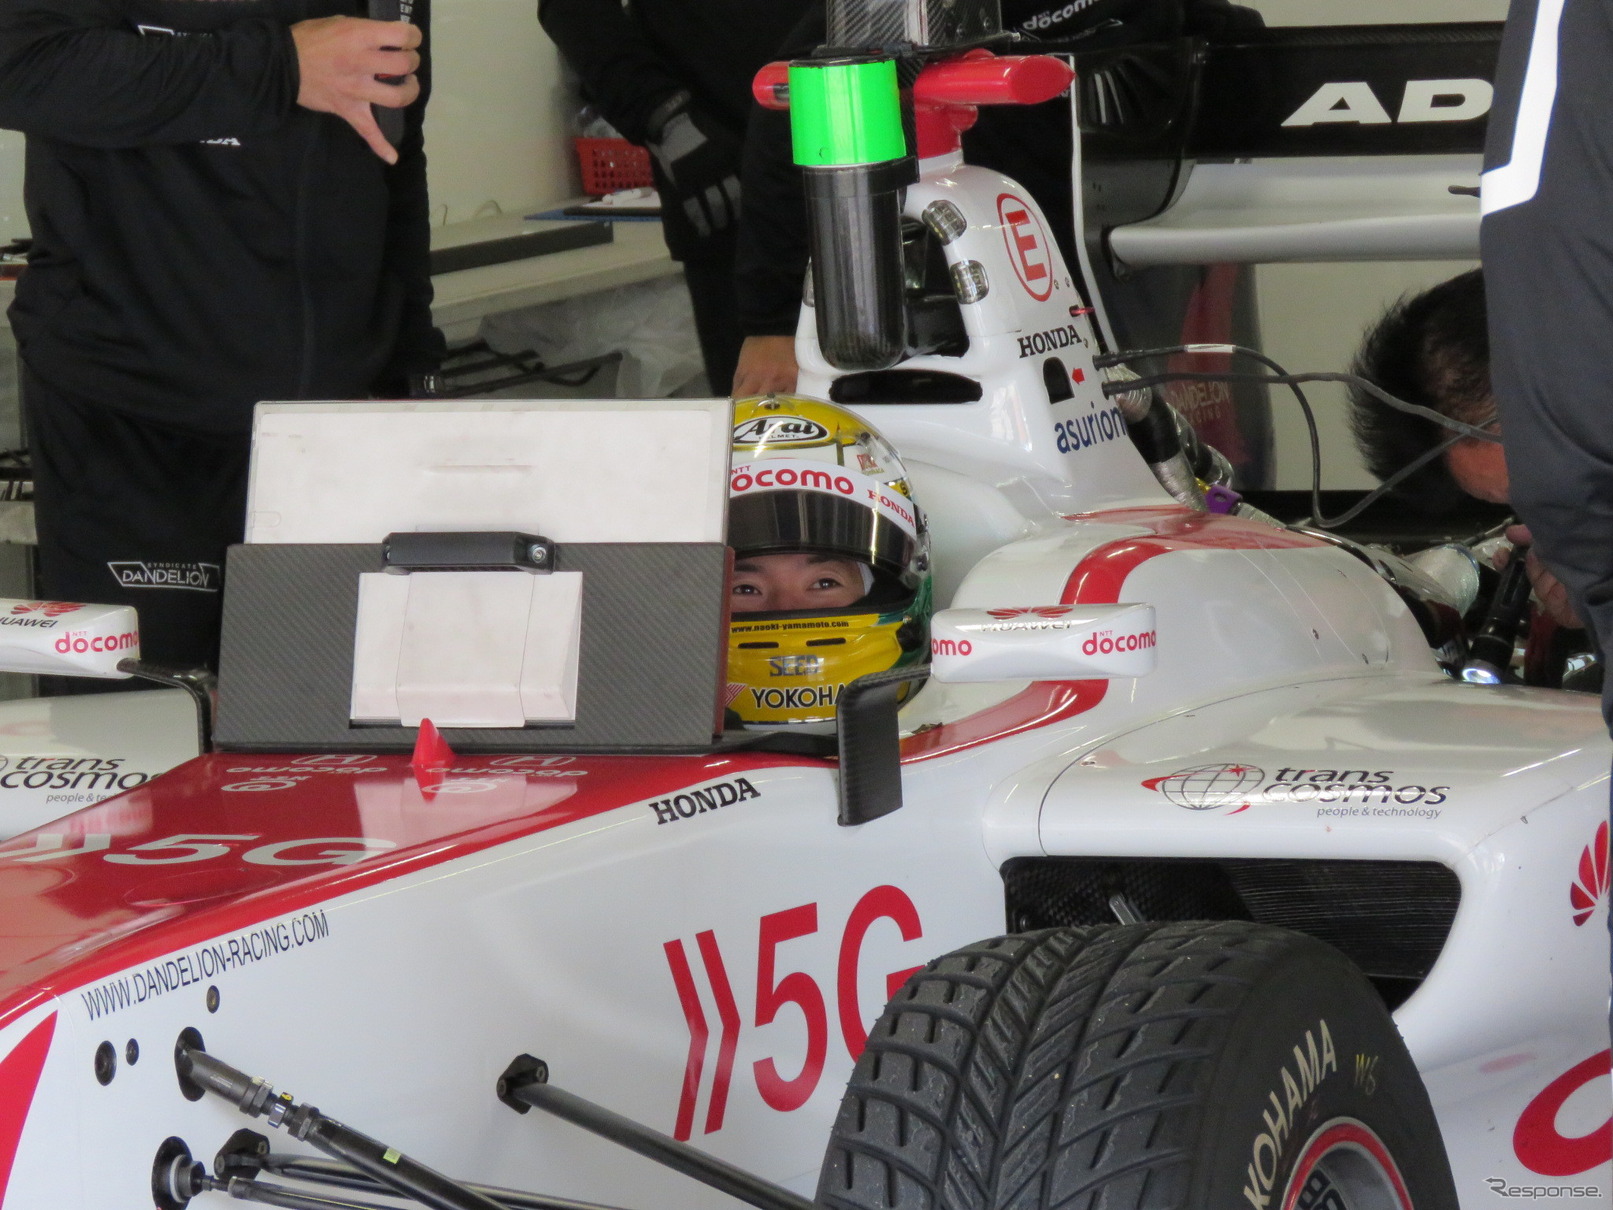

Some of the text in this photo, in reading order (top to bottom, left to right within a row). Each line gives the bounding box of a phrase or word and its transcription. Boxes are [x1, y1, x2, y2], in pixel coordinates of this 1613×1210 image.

[1023, 0, 1098, 30] docom
[1005, 210, 1047, 282] E
[1017, 324, 1082, 358] HONDA
[1054, 400, 1126, 454] asurion
[867, 489, 915, 528] HONDA
[122, 569, 209, 588] DANDELION
[147, 562, 197, 570] SYNDICATE
[731, 620, 849, 633] www.naoki-yamamoto.com
[55, 631, 139, 654] docomo
[1082, 629, 1156, 656] docomo
[16, 756, 125, 771] trans
[1275, 767, 1394, 783] trans
[46, 793, 84, 804] people
[85, 792, 94, 802] &
[648, 777, 761, 825] HONDA
[1263, 783, 1450, 805] cosmos
[1317, 807, 1442, 819] people & technology
[103, 833, 396, 865] 5G
[81, 909, 329, 1021] WWW.DANDELION-RACING.COM
